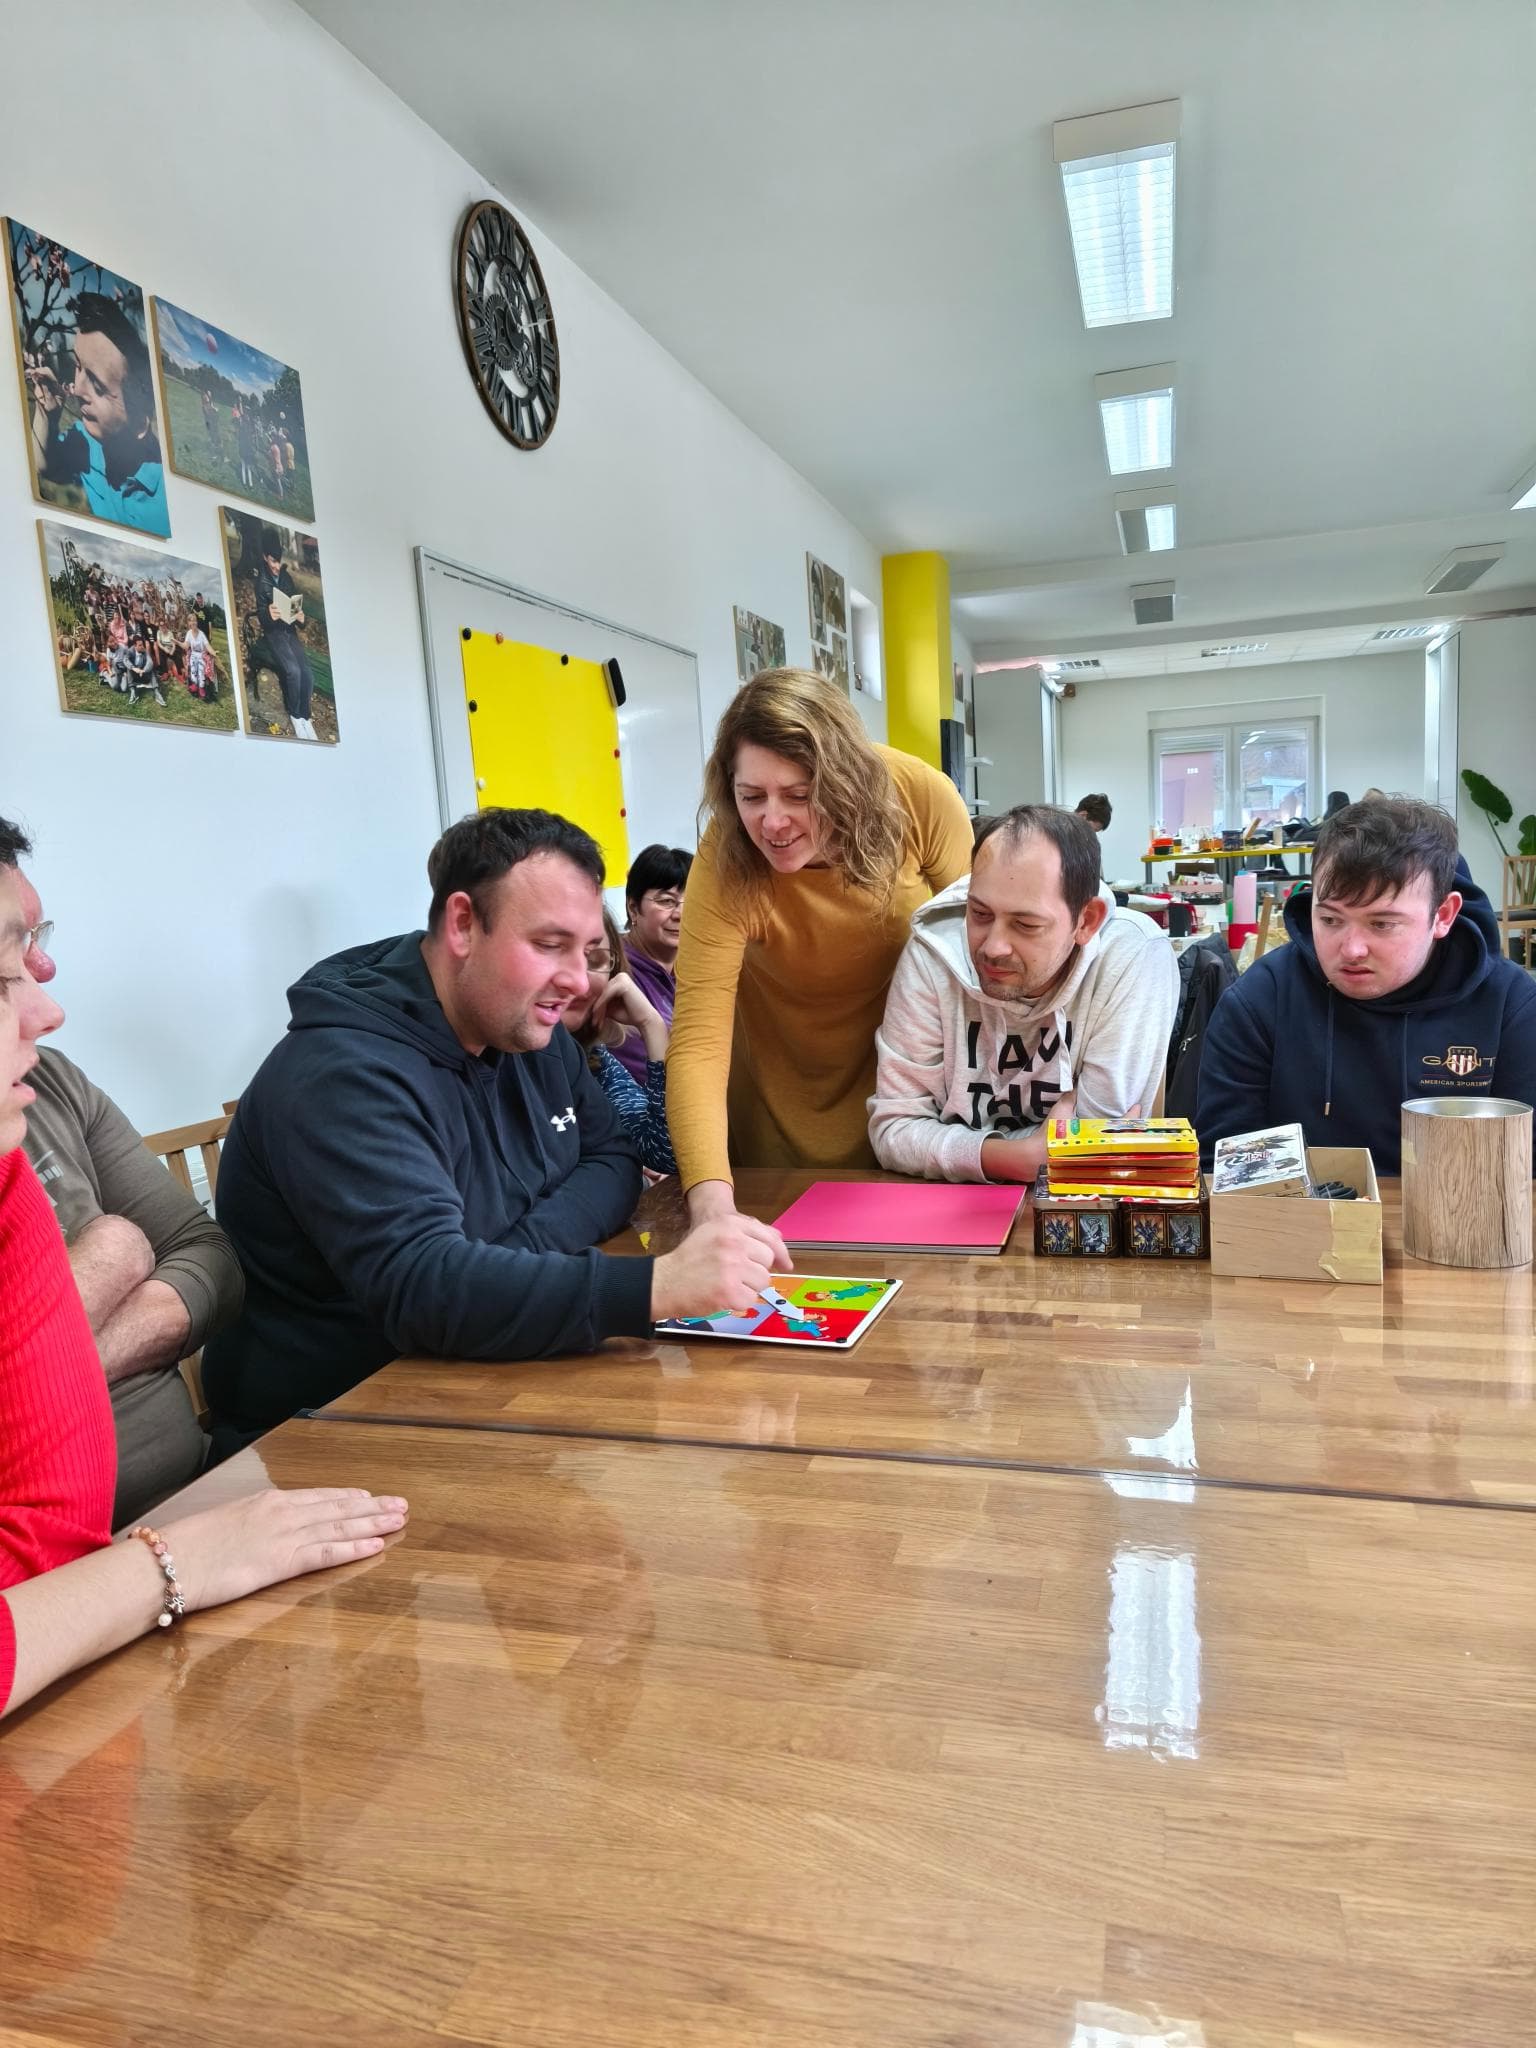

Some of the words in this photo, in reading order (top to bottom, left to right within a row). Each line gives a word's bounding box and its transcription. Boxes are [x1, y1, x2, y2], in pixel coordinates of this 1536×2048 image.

[967, 1021, 982, 1069] I
[1422, 1055, 1496, 1067] GANT
[967, 1080, 1060, 1130] THE
